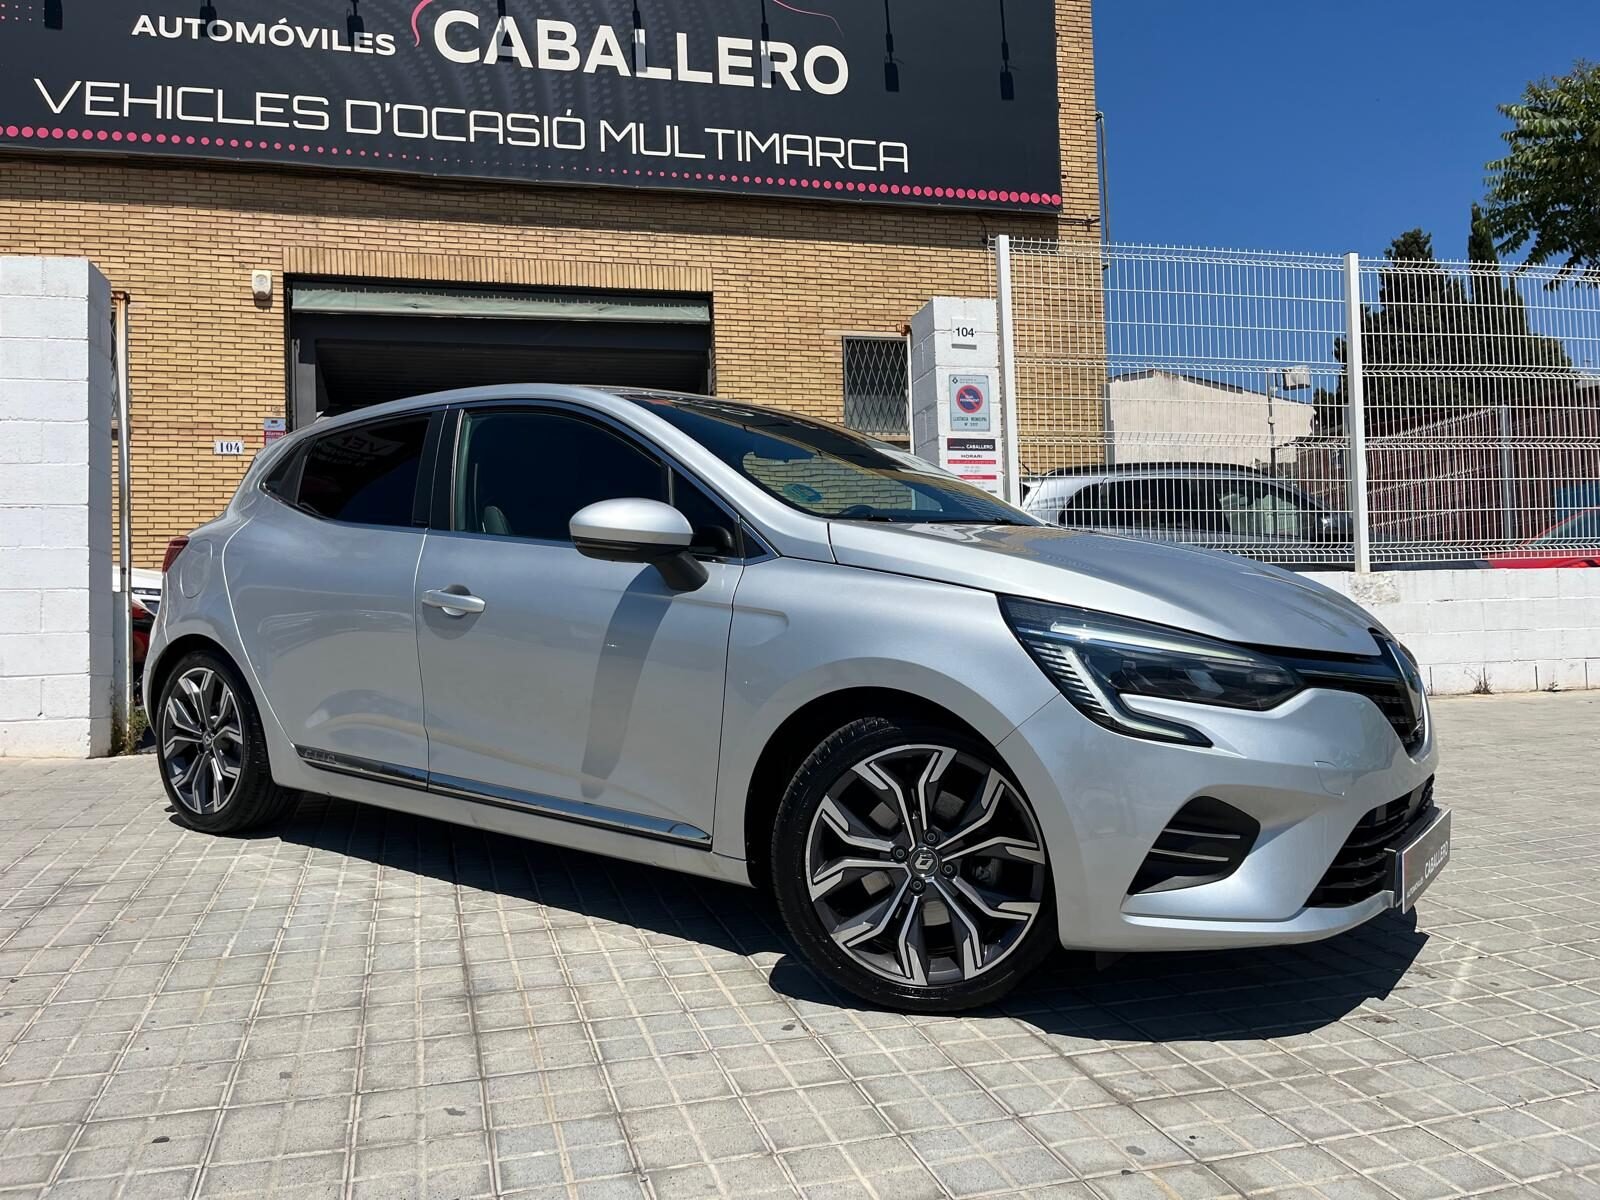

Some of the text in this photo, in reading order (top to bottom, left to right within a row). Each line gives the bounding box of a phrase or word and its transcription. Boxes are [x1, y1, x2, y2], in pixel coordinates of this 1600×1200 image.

[131, 9, 850, 97] AUTOMÓVILES CABALLERO
[34, 77, 909, 173] VEHICLES D'OCASIÓ MULTIMARCA
[955, 327, 975, 338] 104
[219, 442, 240, 453] 104
[1425, 840, 1449, 879] CABALLERO
